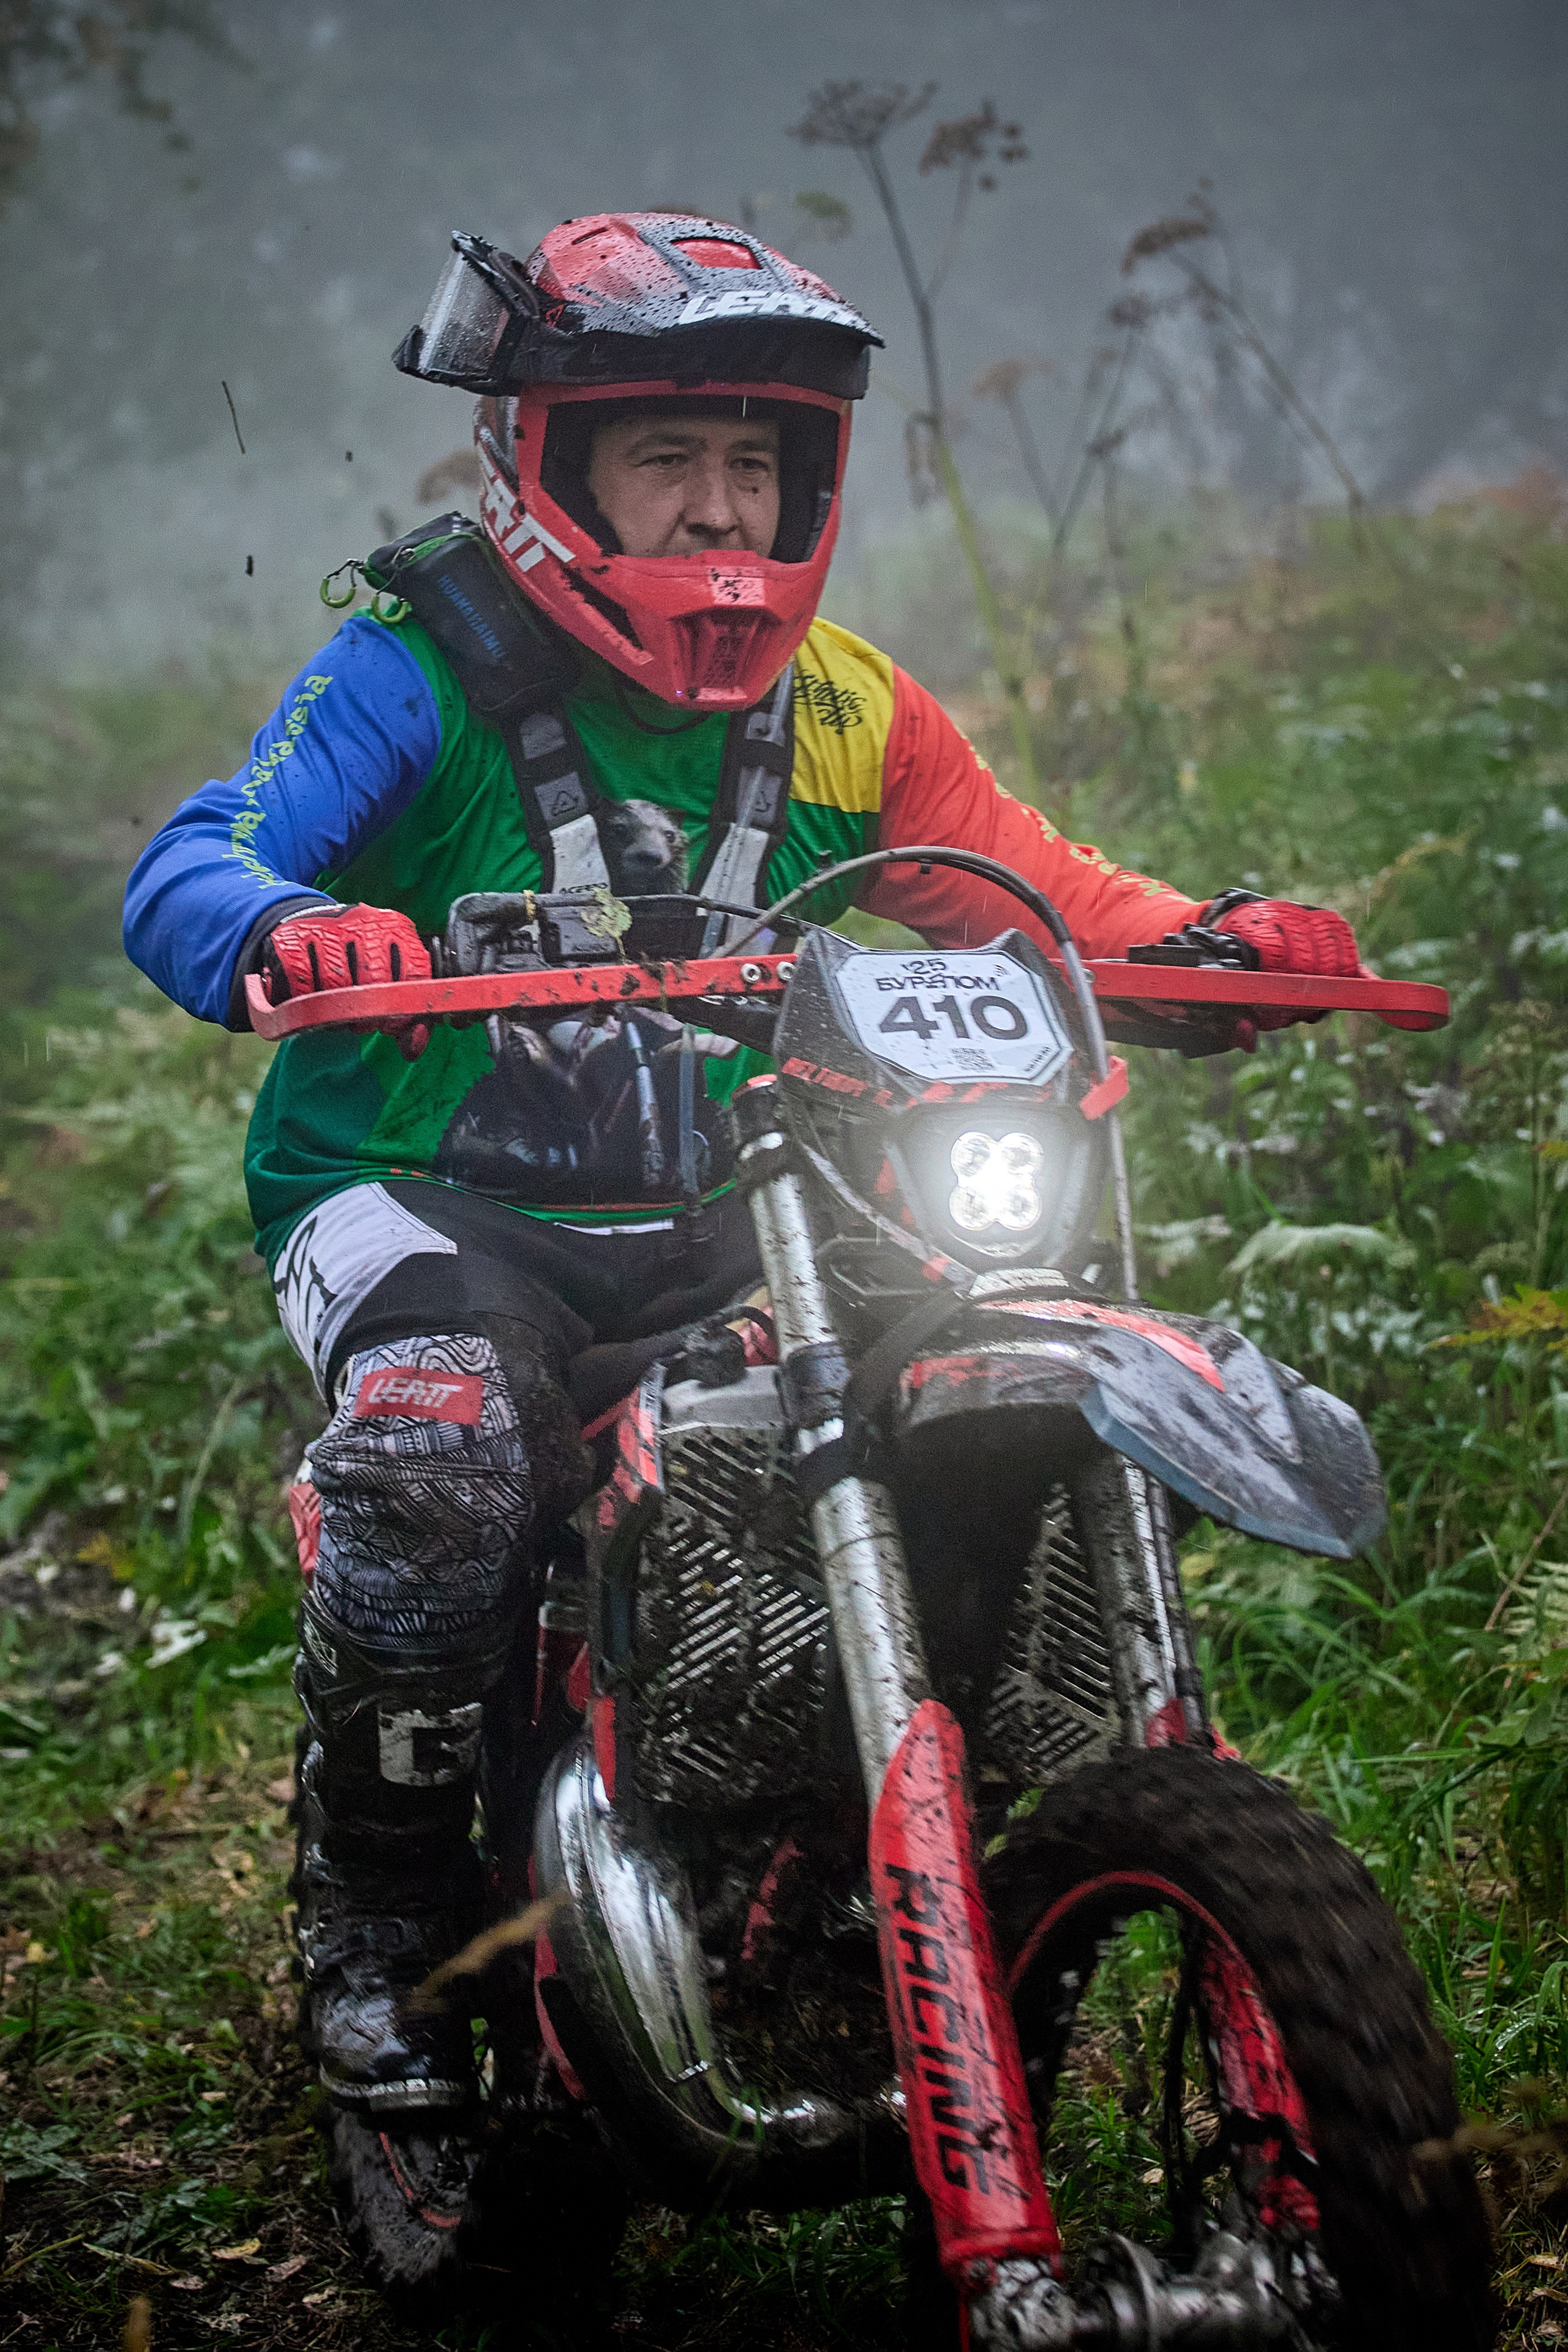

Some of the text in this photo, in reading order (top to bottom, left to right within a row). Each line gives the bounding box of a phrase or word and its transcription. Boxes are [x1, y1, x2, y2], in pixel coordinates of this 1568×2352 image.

[478, 441, 576, 572] ATT
[878, 995, 1028, 1040] 410
[368, 1378, 463, 1408] LEATT
[886, 1862, 991, 2195] RACING
